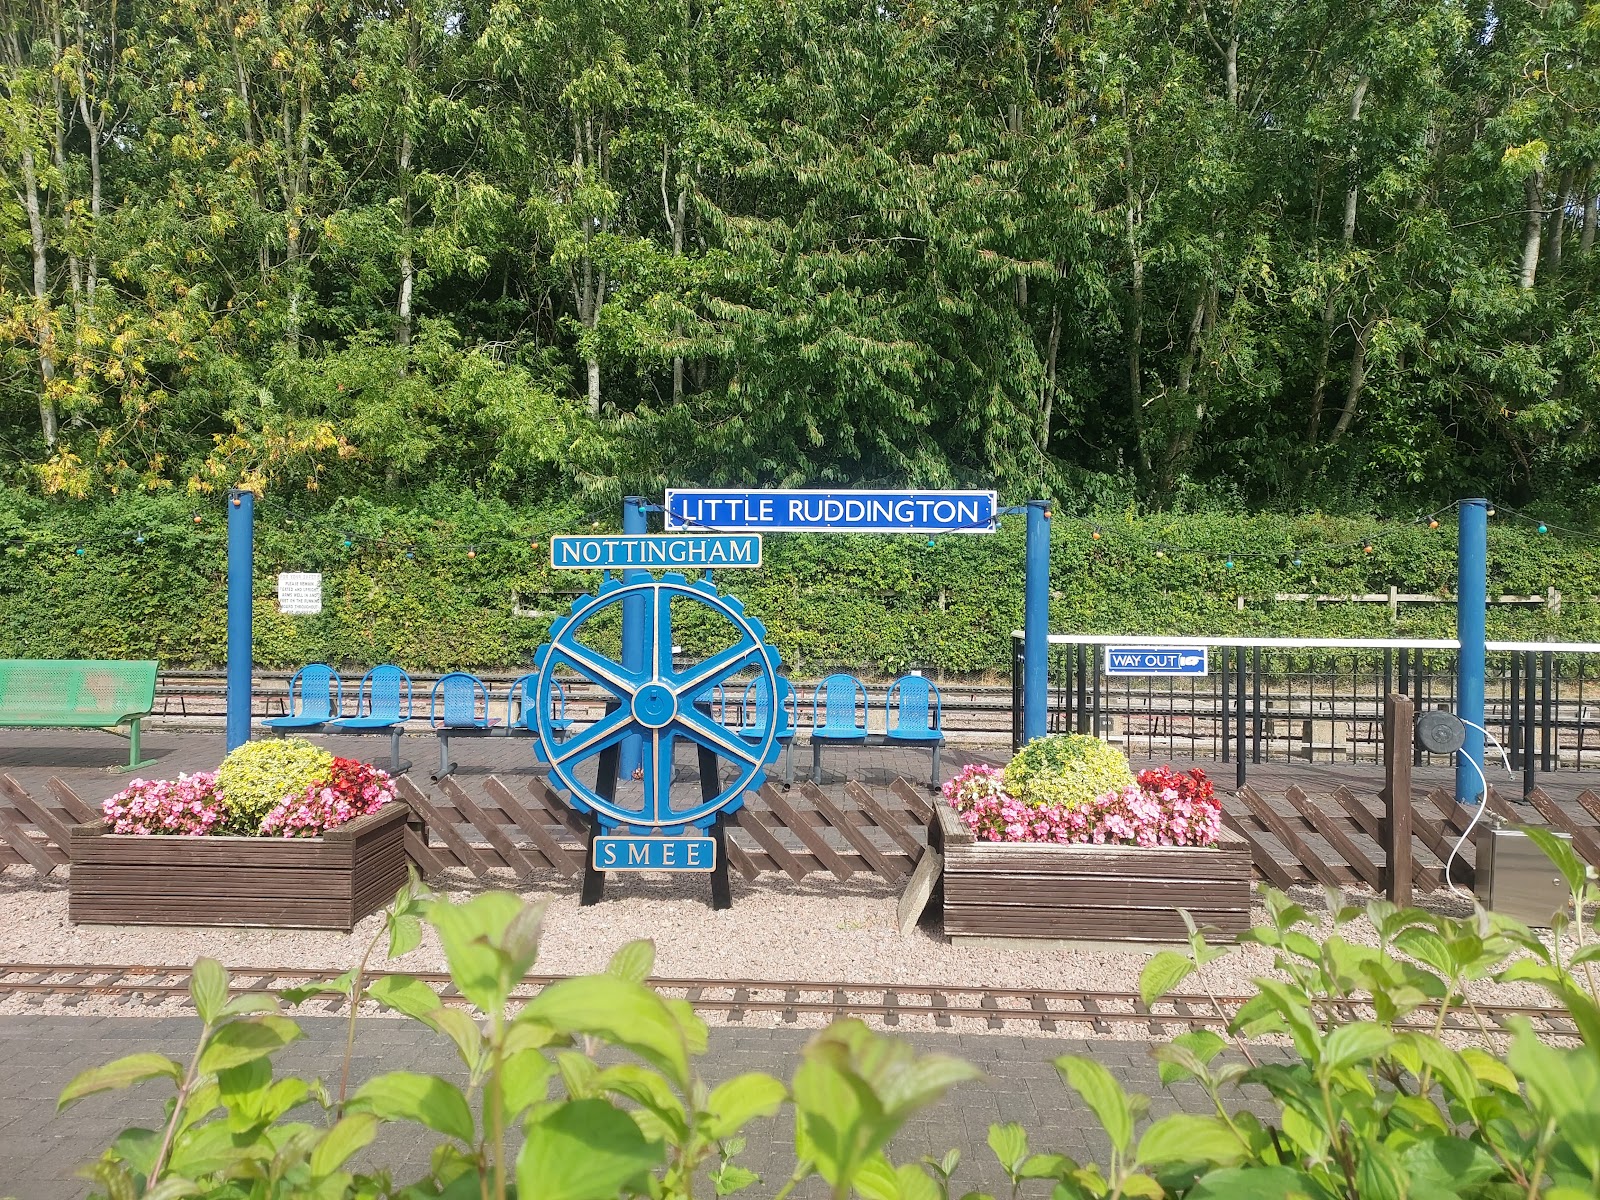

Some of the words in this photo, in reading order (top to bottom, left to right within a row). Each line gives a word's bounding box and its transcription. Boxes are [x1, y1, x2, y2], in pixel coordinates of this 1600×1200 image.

[682, 499, 773, 521] LITTLE
[788, 500, 978, 522] RUDDINGTON
[561, 540, 752, 563] NOTTINGHAM
[1112, 655, 1142, 667] WAY
[1145, 655, 1177, 667] OUT
[604, 843, 700, 866] SMEE
